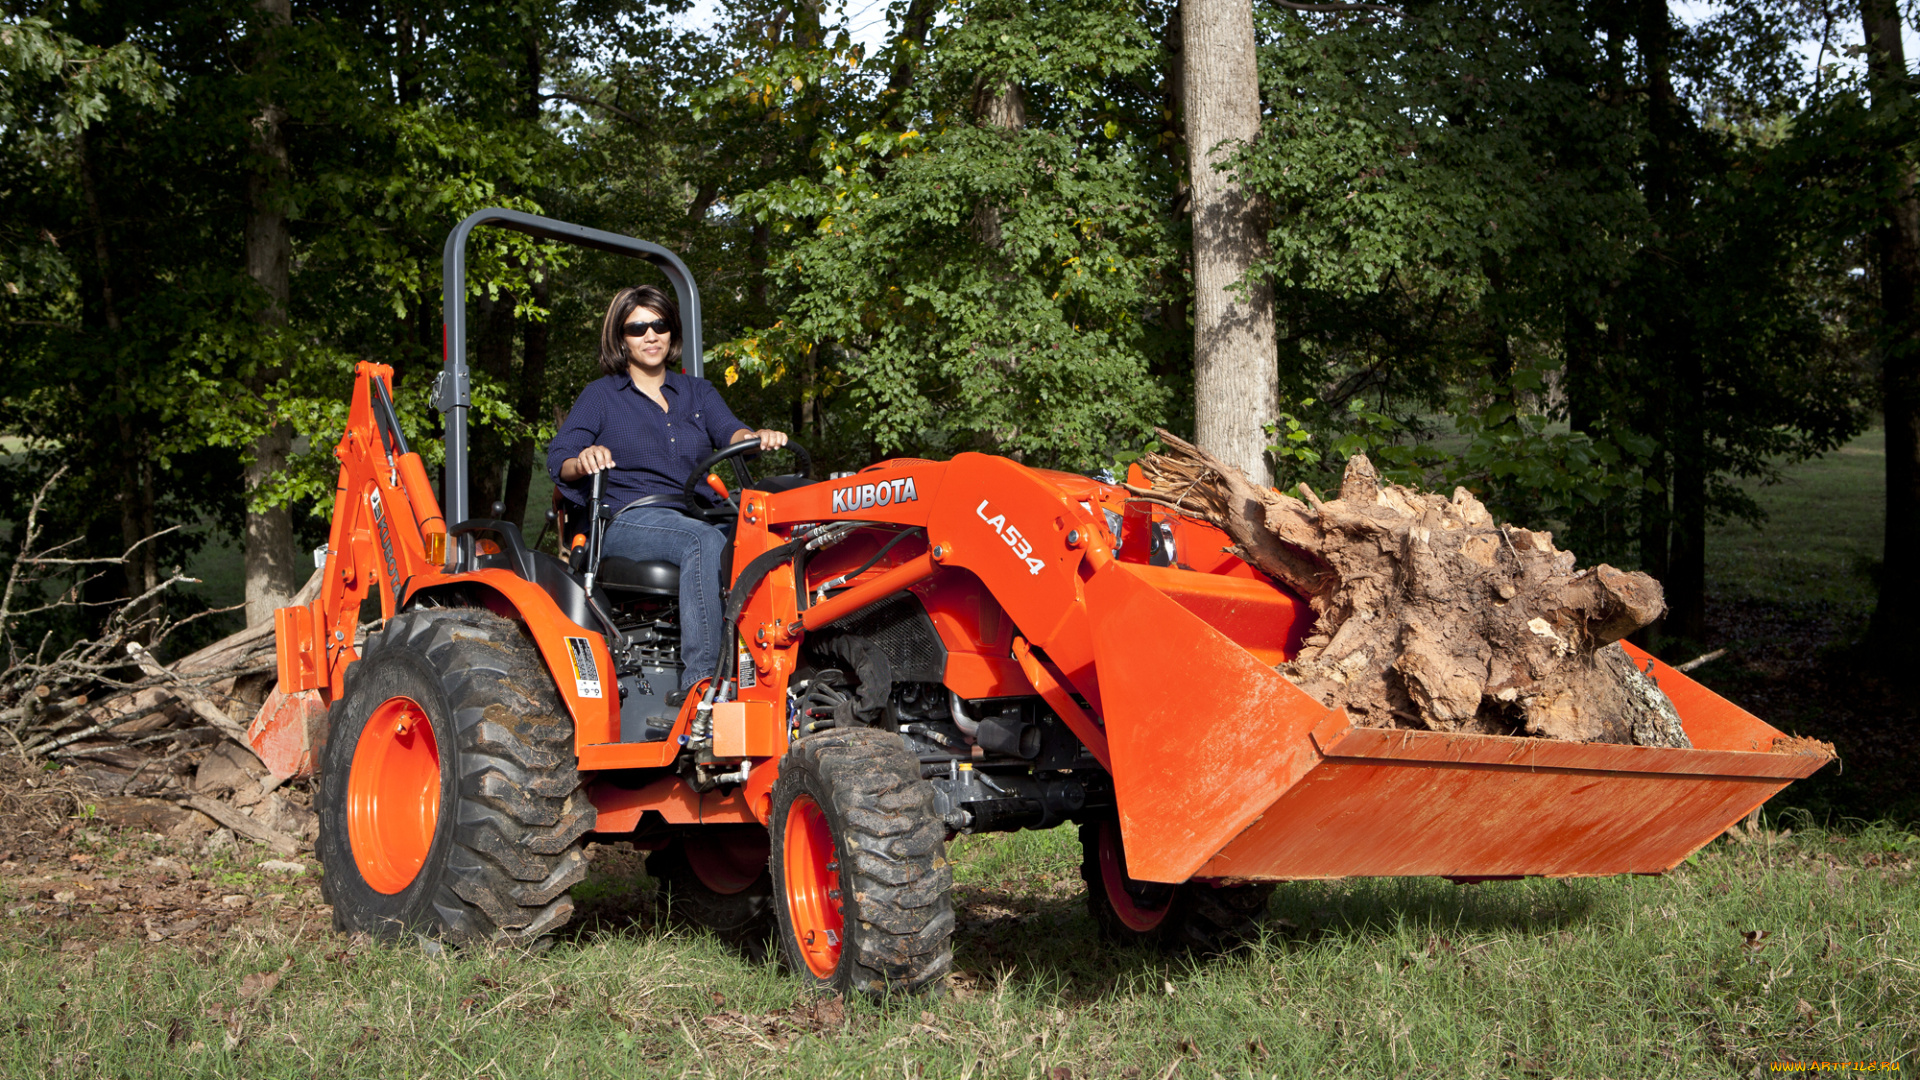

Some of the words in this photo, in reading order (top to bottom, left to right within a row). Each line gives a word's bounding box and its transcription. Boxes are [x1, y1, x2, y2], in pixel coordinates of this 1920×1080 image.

[832, 477, 918, 513] KUBOTA
[377, 516, 402, 602] KUBOTA
[976, 499, 1046, 576] LA534
